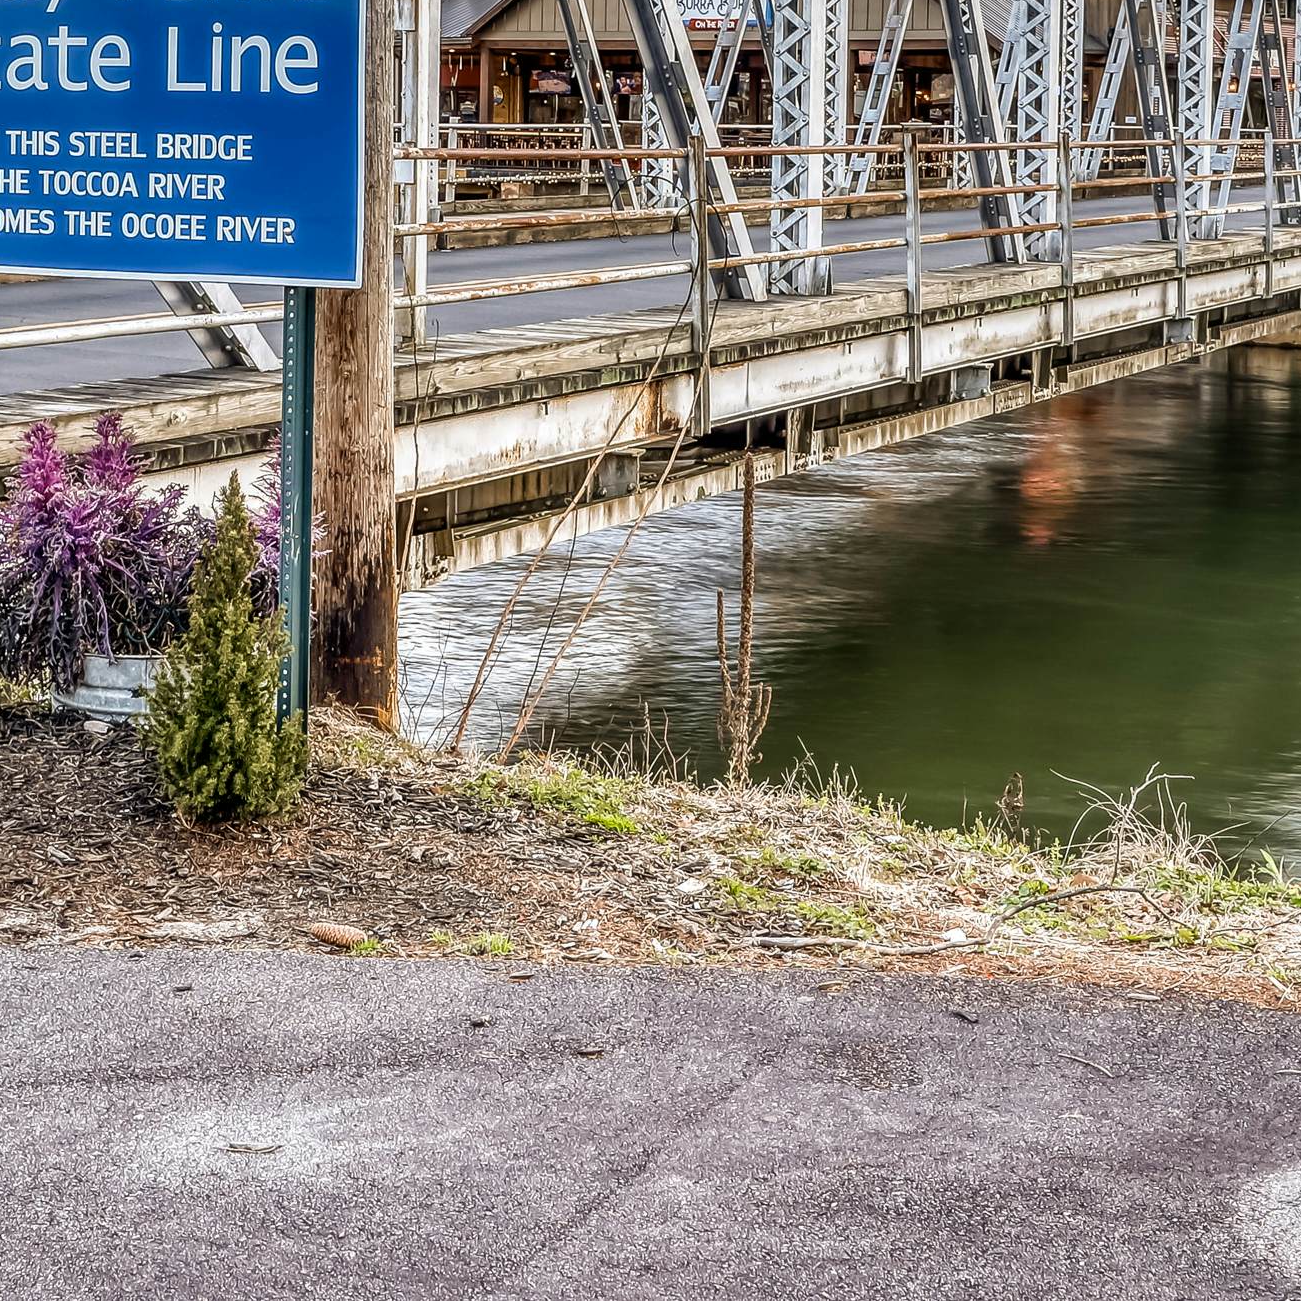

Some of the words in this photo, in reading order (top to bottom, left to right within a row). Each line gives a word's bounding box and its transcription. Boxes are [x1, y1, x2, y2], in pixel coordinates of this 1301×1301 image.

[695, 20, 706, 29] ON
[167, 22, 319, 94] Line
[5, 130, 60, 156] THIS
[69, 131, 147, 158] STEEL
[156, 133, 253, 161] BRIDGE
[38, 170, 139, 198] TOCCOA
[148, 173, 226, 200] RIVER
[63, 210, 112, 237] THE
[121, 212, 207, 241] OCOEE
[216, 215, 297, 244] RIVER
